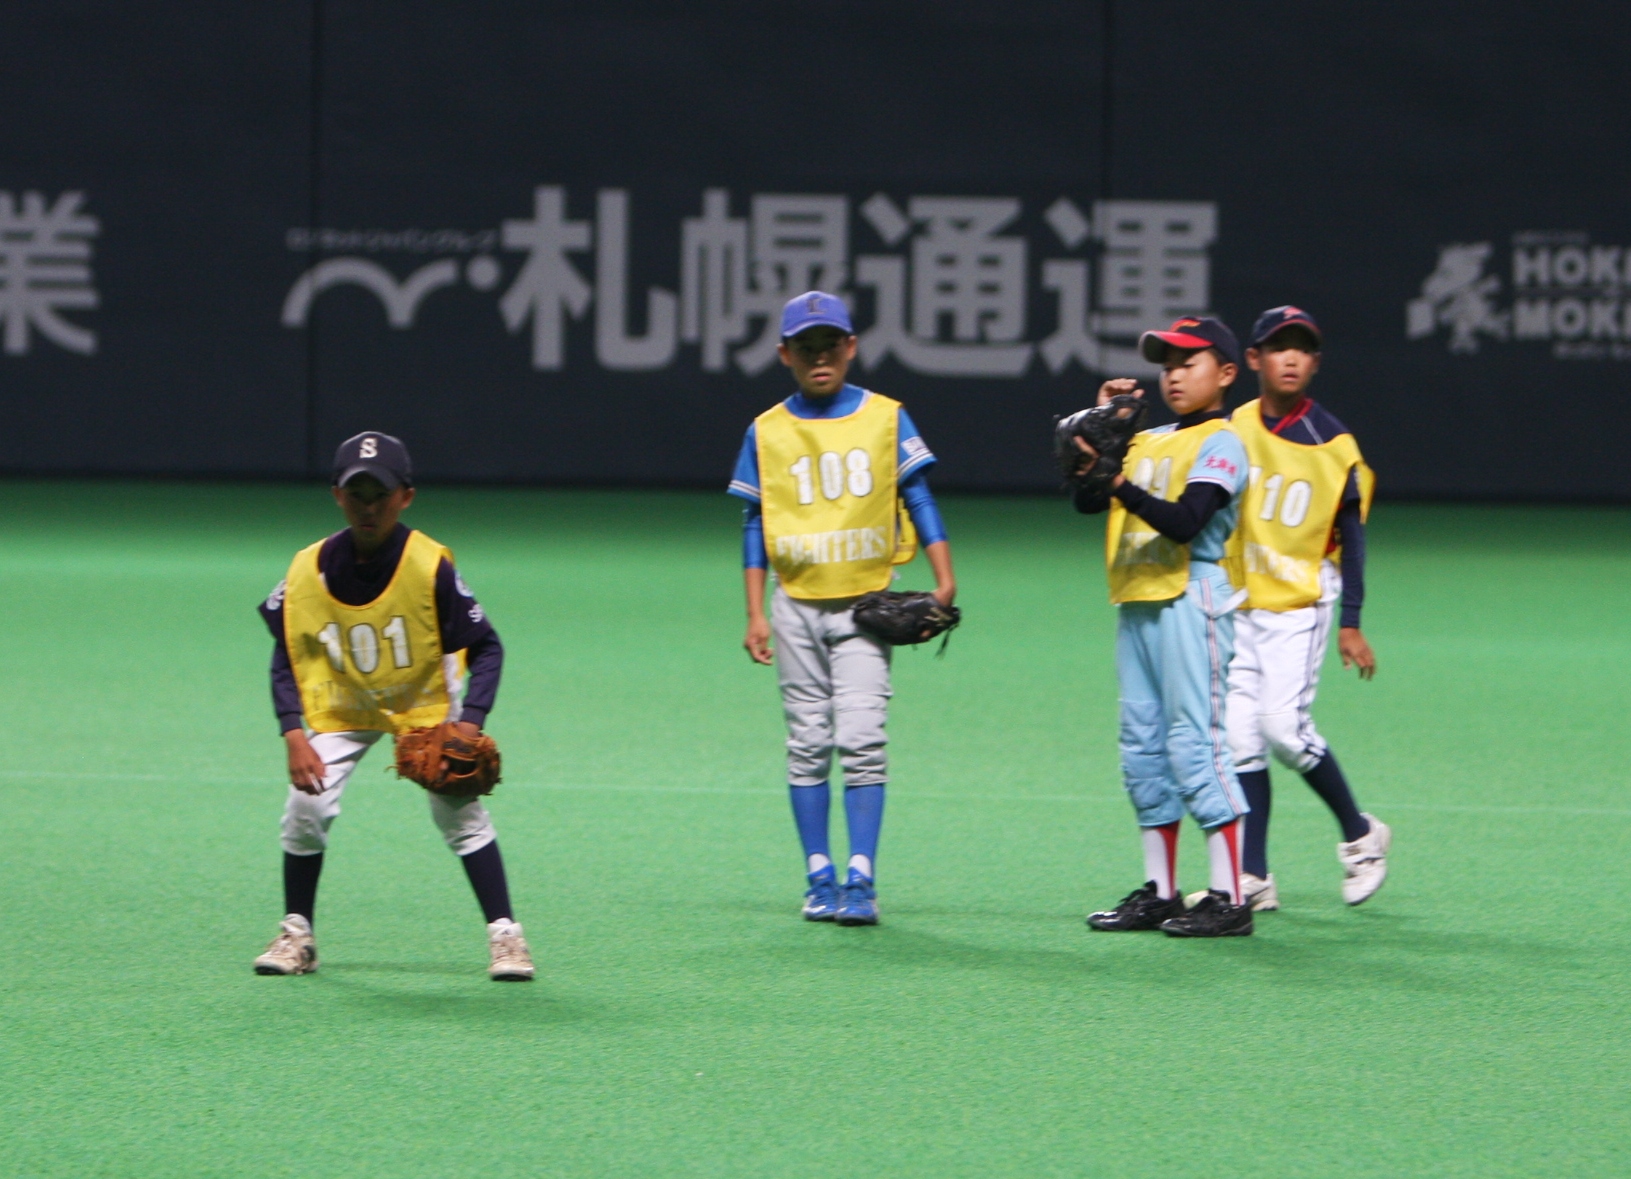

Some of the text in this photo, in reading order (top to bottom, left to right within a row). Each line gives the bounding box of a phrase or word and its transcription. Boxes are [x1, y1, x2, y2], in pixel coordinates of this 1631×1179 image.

[0, 190, 100, 354] 業
[501, 186, 1218, 376] 札幌通運
[1513, 247, 1631, 286] HOK
[1514, 300, 1631, 339] MOK
[359, 438, 378, 459] S
[789, 449, 872, 505] 108
[317, 615, 412, 674] 101
